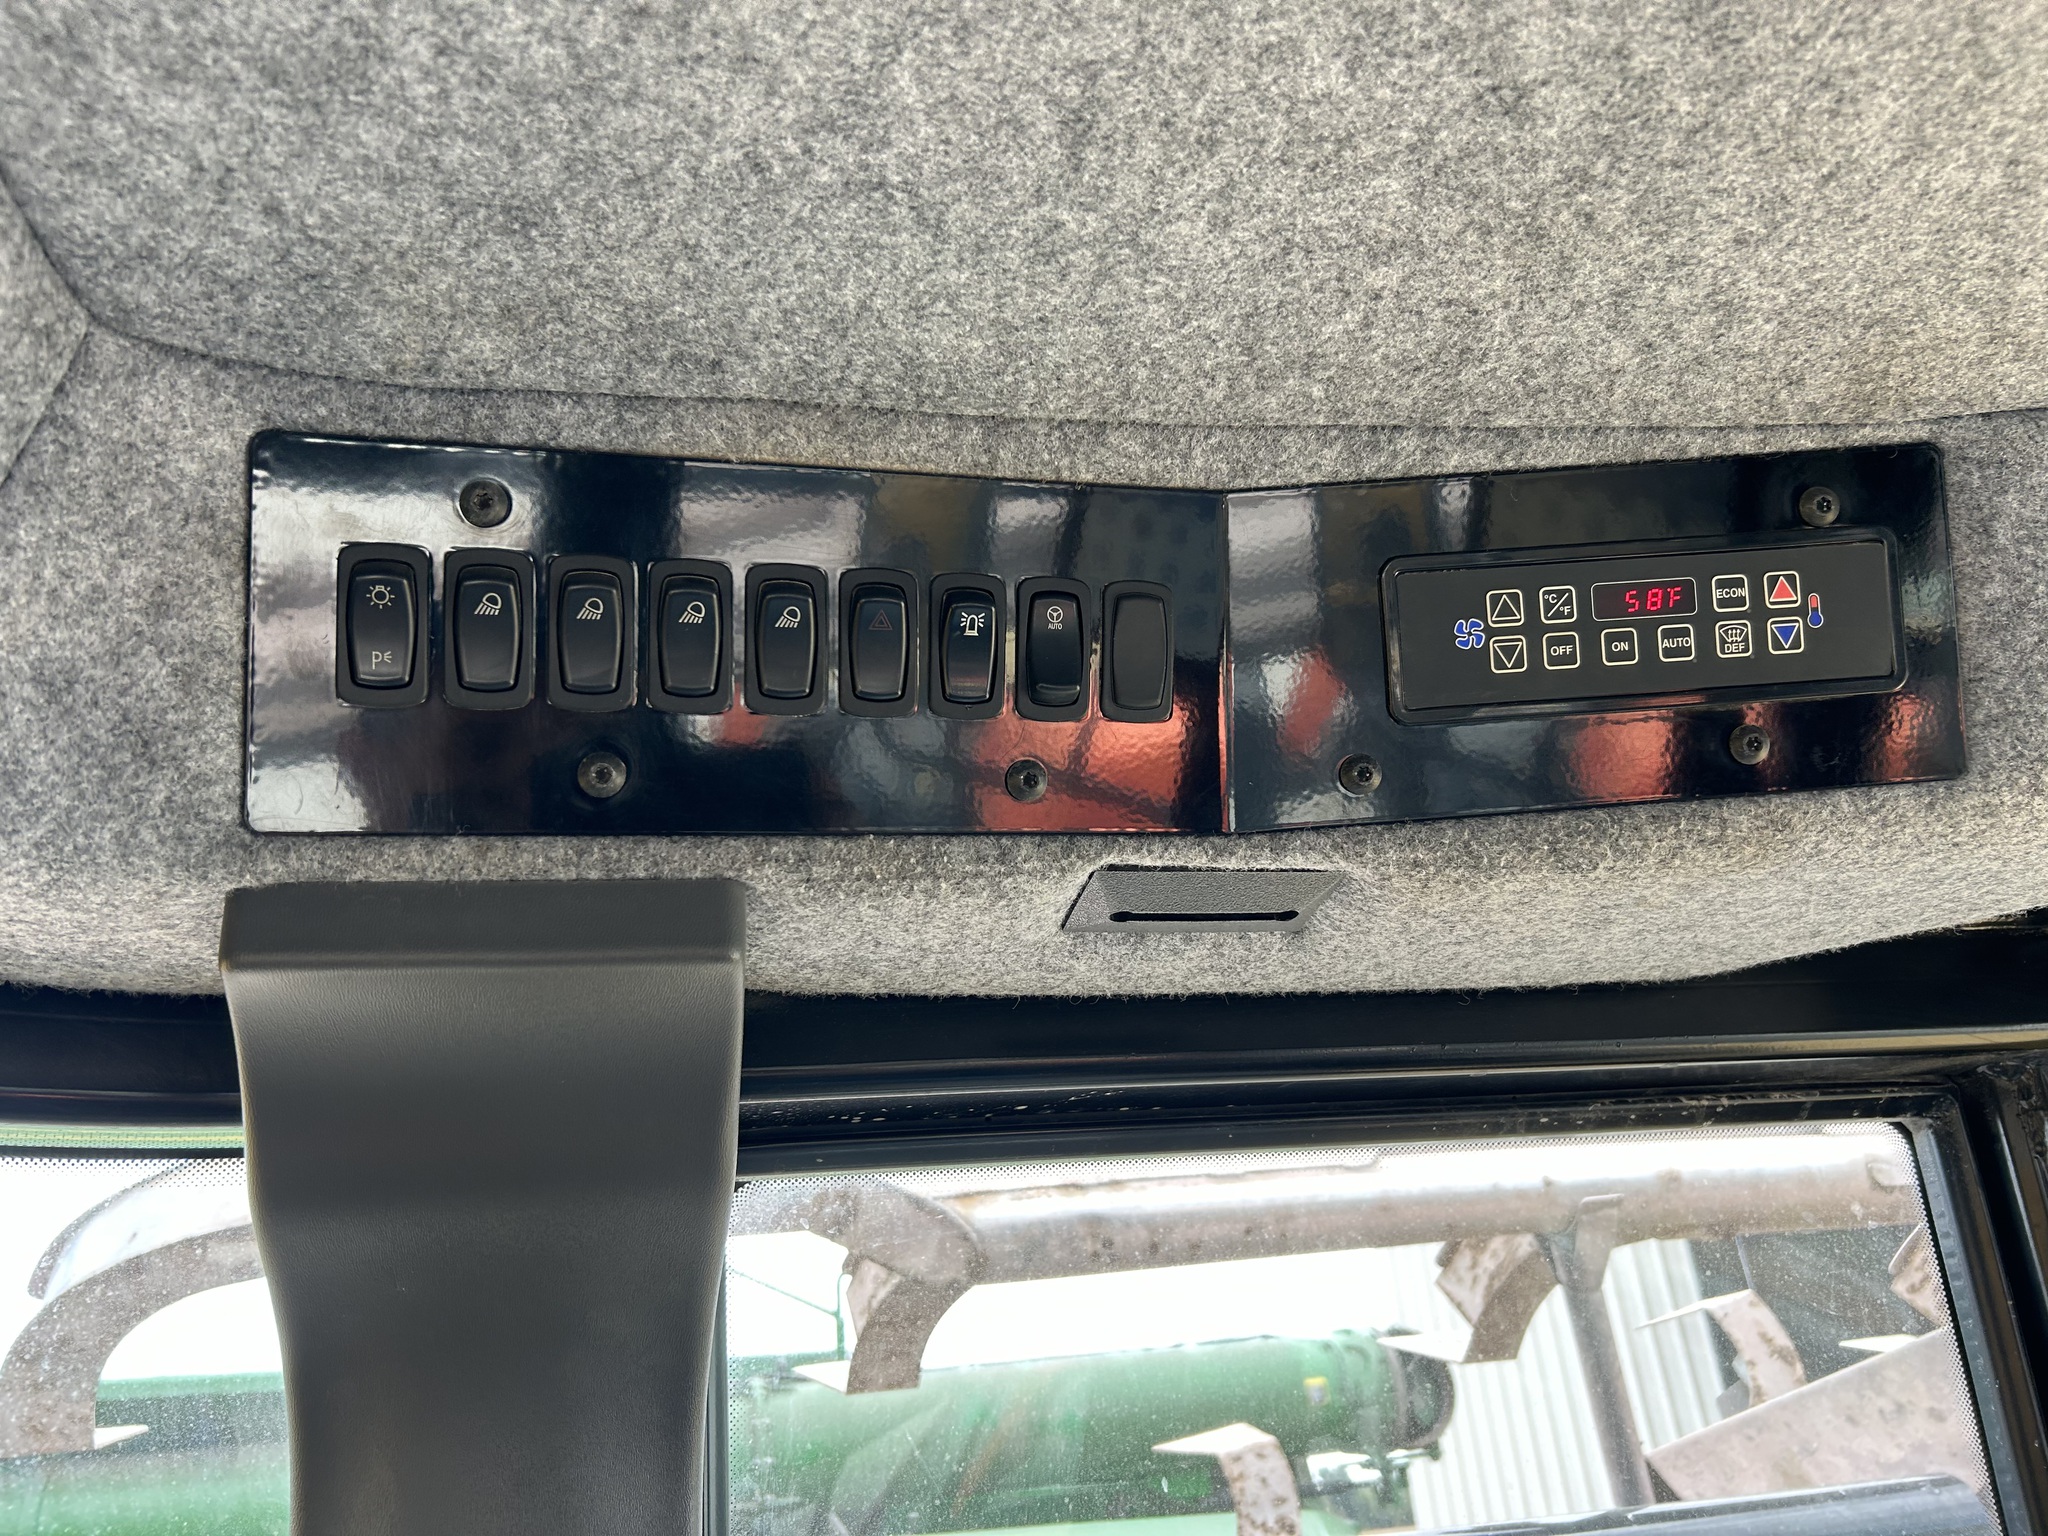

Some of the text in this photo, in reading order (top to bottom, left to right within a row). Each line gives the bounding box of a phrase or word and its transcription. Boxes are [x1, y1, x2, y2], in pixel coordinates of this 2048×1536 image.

[1716, 587, 1745, 599] ECON
[1611, 642, 1629, 652] ON
[1662, 637, 1691, 648] AUTO
[1550, 645, 1573, 656] OFF
[1724, 643, 1745, 654] DEF
